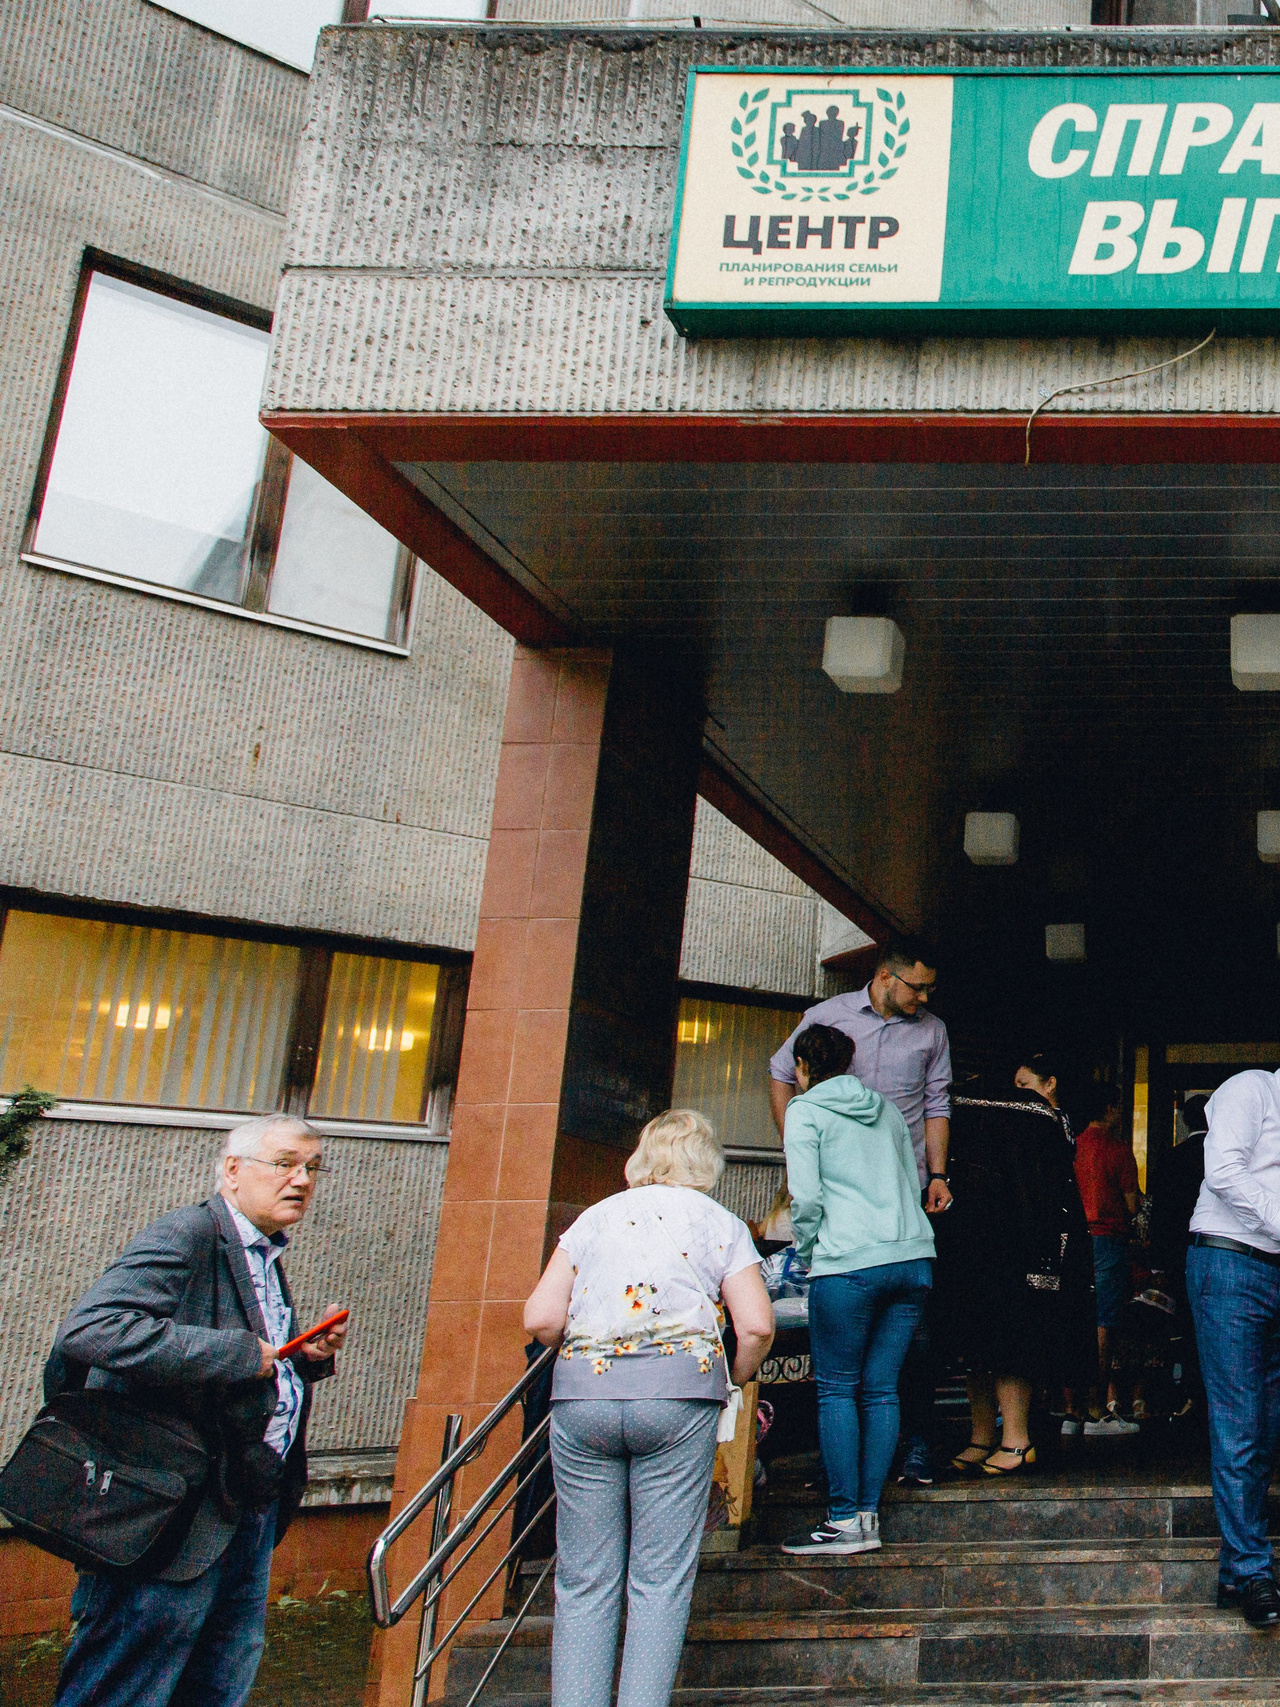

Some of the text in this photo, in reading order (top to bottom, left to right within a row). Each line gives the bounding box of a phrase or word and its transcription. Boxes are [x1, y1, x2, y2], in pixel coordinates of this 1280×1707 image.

[722, 214, 900, 255] ЦЕНТР
[719, 262, 898, 273] ПЛАНИРОВАНИЯ СЕМЬИ
[743, 277, 871, 288] И РЕПРОДУКЦИИ
